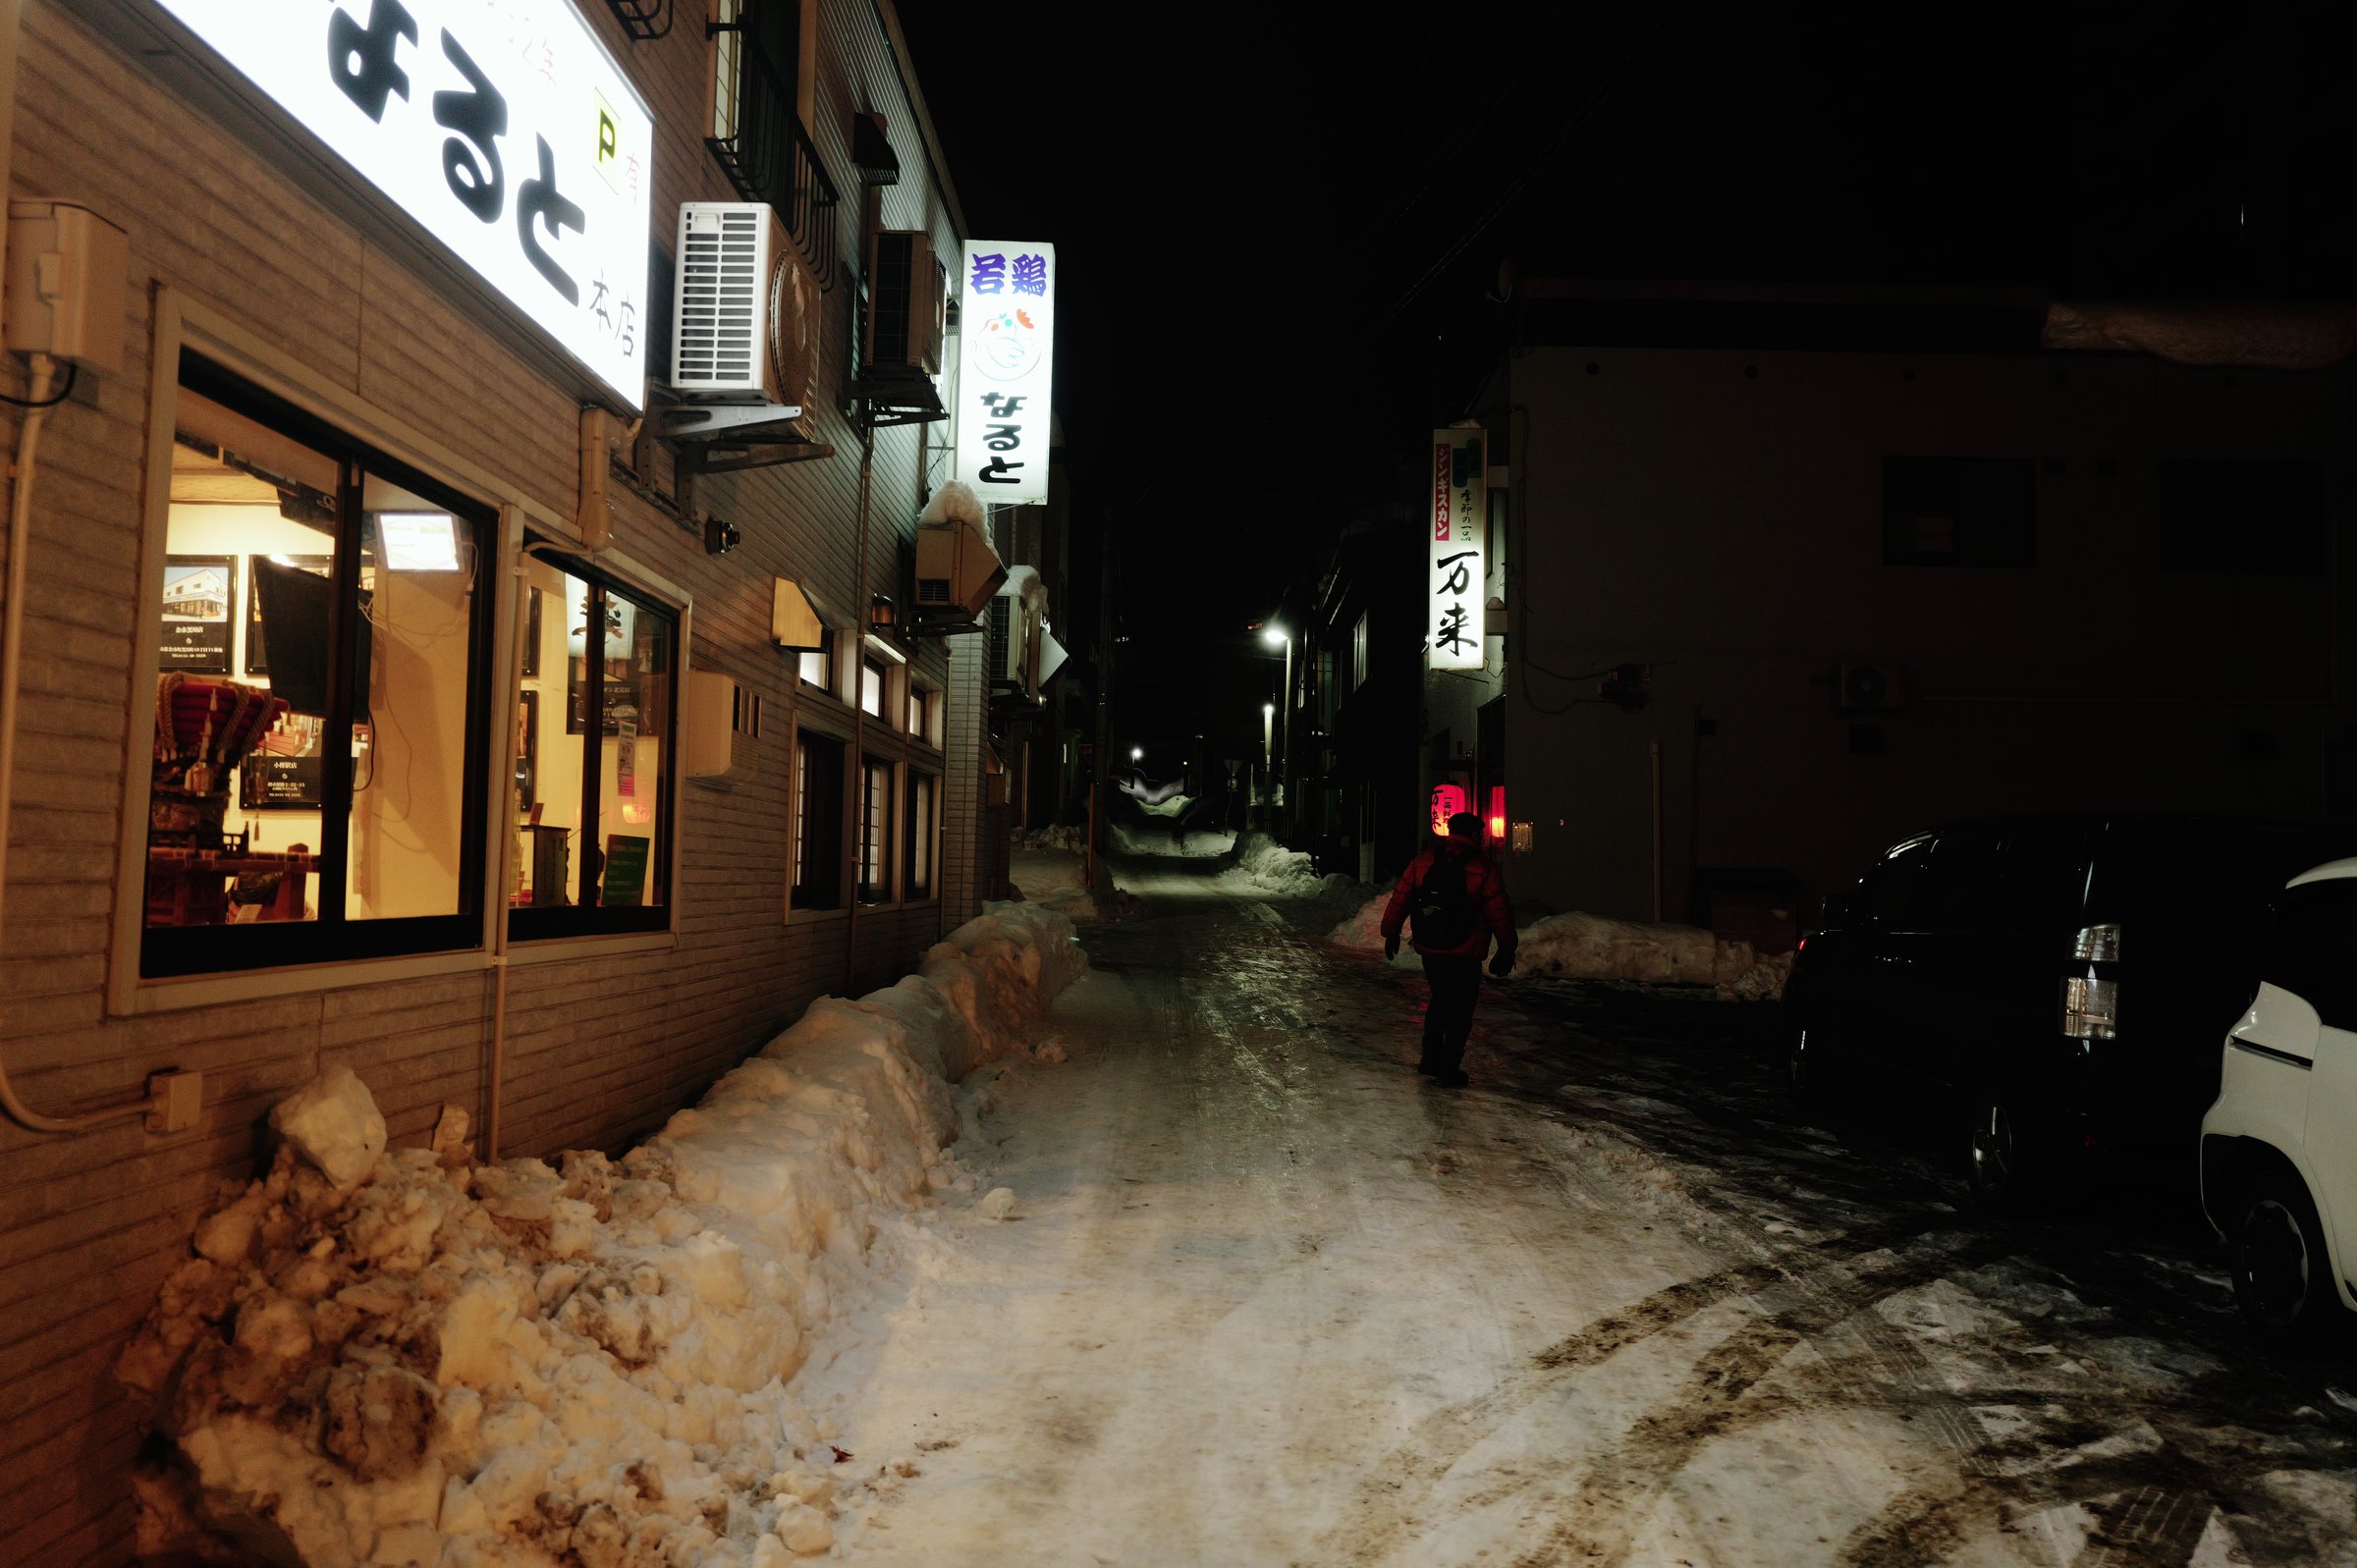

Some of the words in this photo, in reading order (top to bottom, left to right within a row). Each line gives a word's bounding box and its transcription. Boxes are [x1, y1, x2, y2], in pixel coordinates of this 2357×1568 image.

[598, 108, 616, 163] P
[970, 252, 1047, 297] 若鶏
[589, 267, 635, 357] 本店
[978, 392, 1028, 484] なると
[1437, 448, 1449, 537] ジンギスカン
[1459, 489, 1473, 542] 季節の一品
[1436, 550, 1479, 657] 万来
[1444, 796, 1453, 824] 一品料
